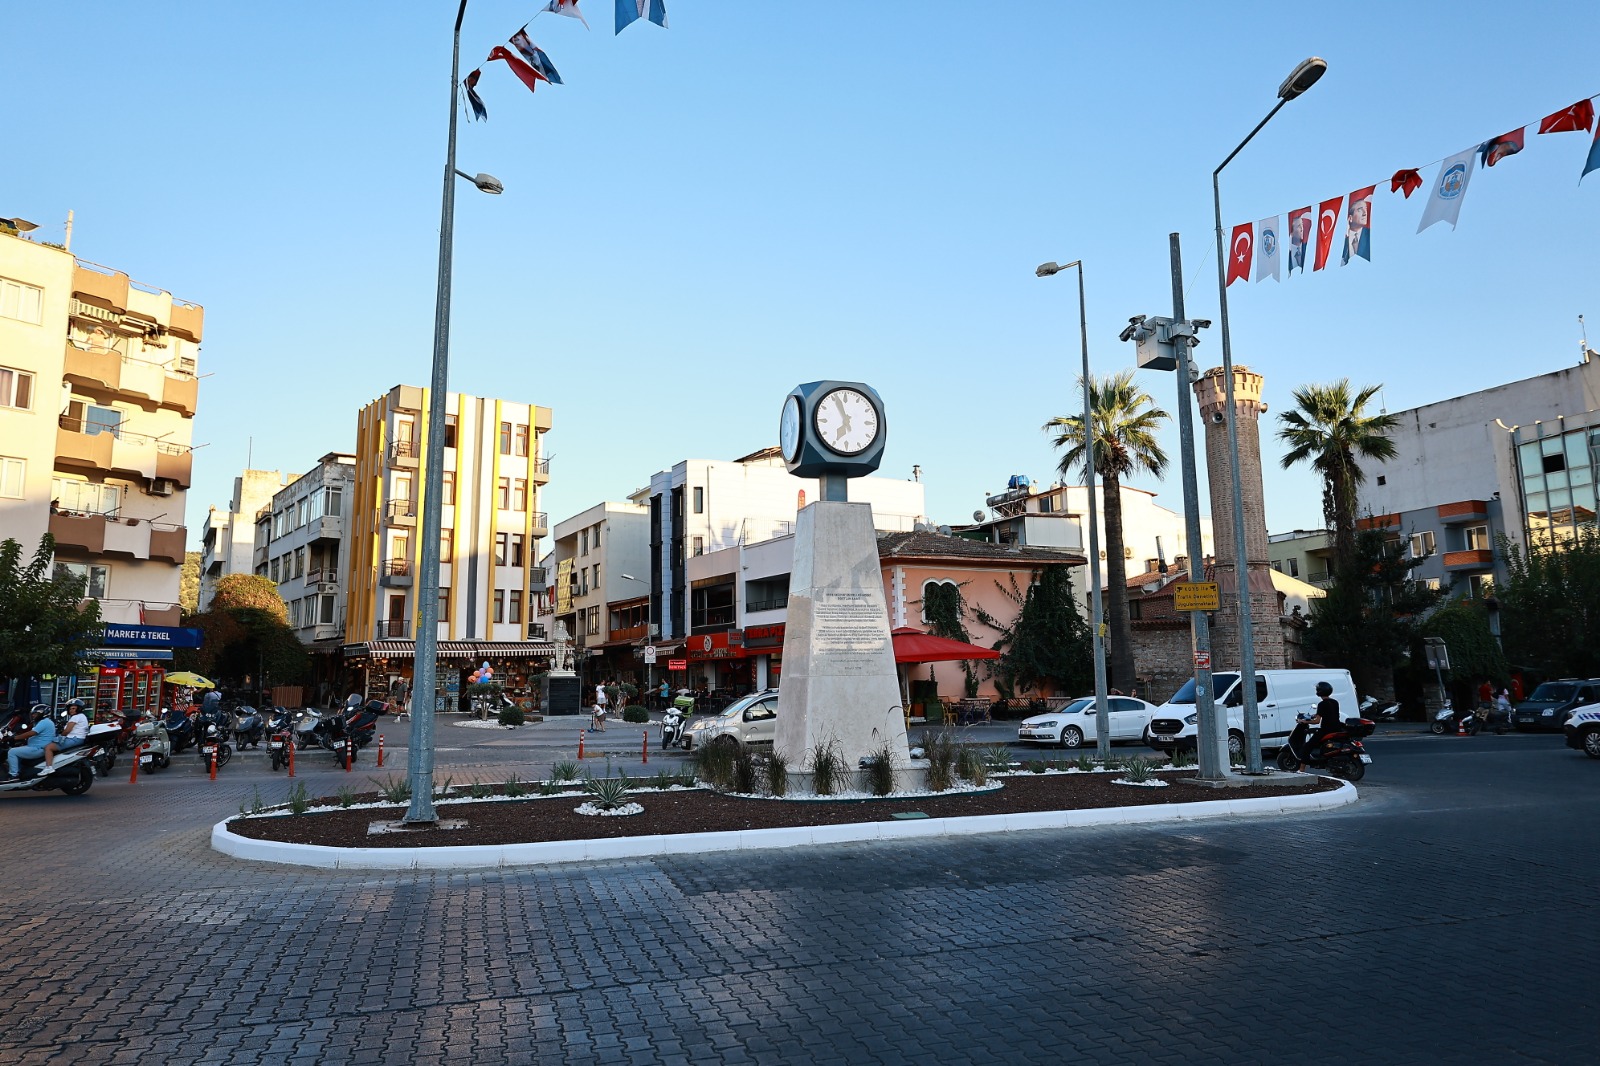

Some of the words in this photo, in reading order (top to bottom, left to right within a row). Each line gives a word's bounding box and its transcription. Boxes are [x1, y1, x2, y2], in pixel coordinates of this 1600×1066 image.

[108, 630, 140, 638] MARKET
[148, 632, 170, 640] TEKEL
[746, 628, 769, 639] TERRA
